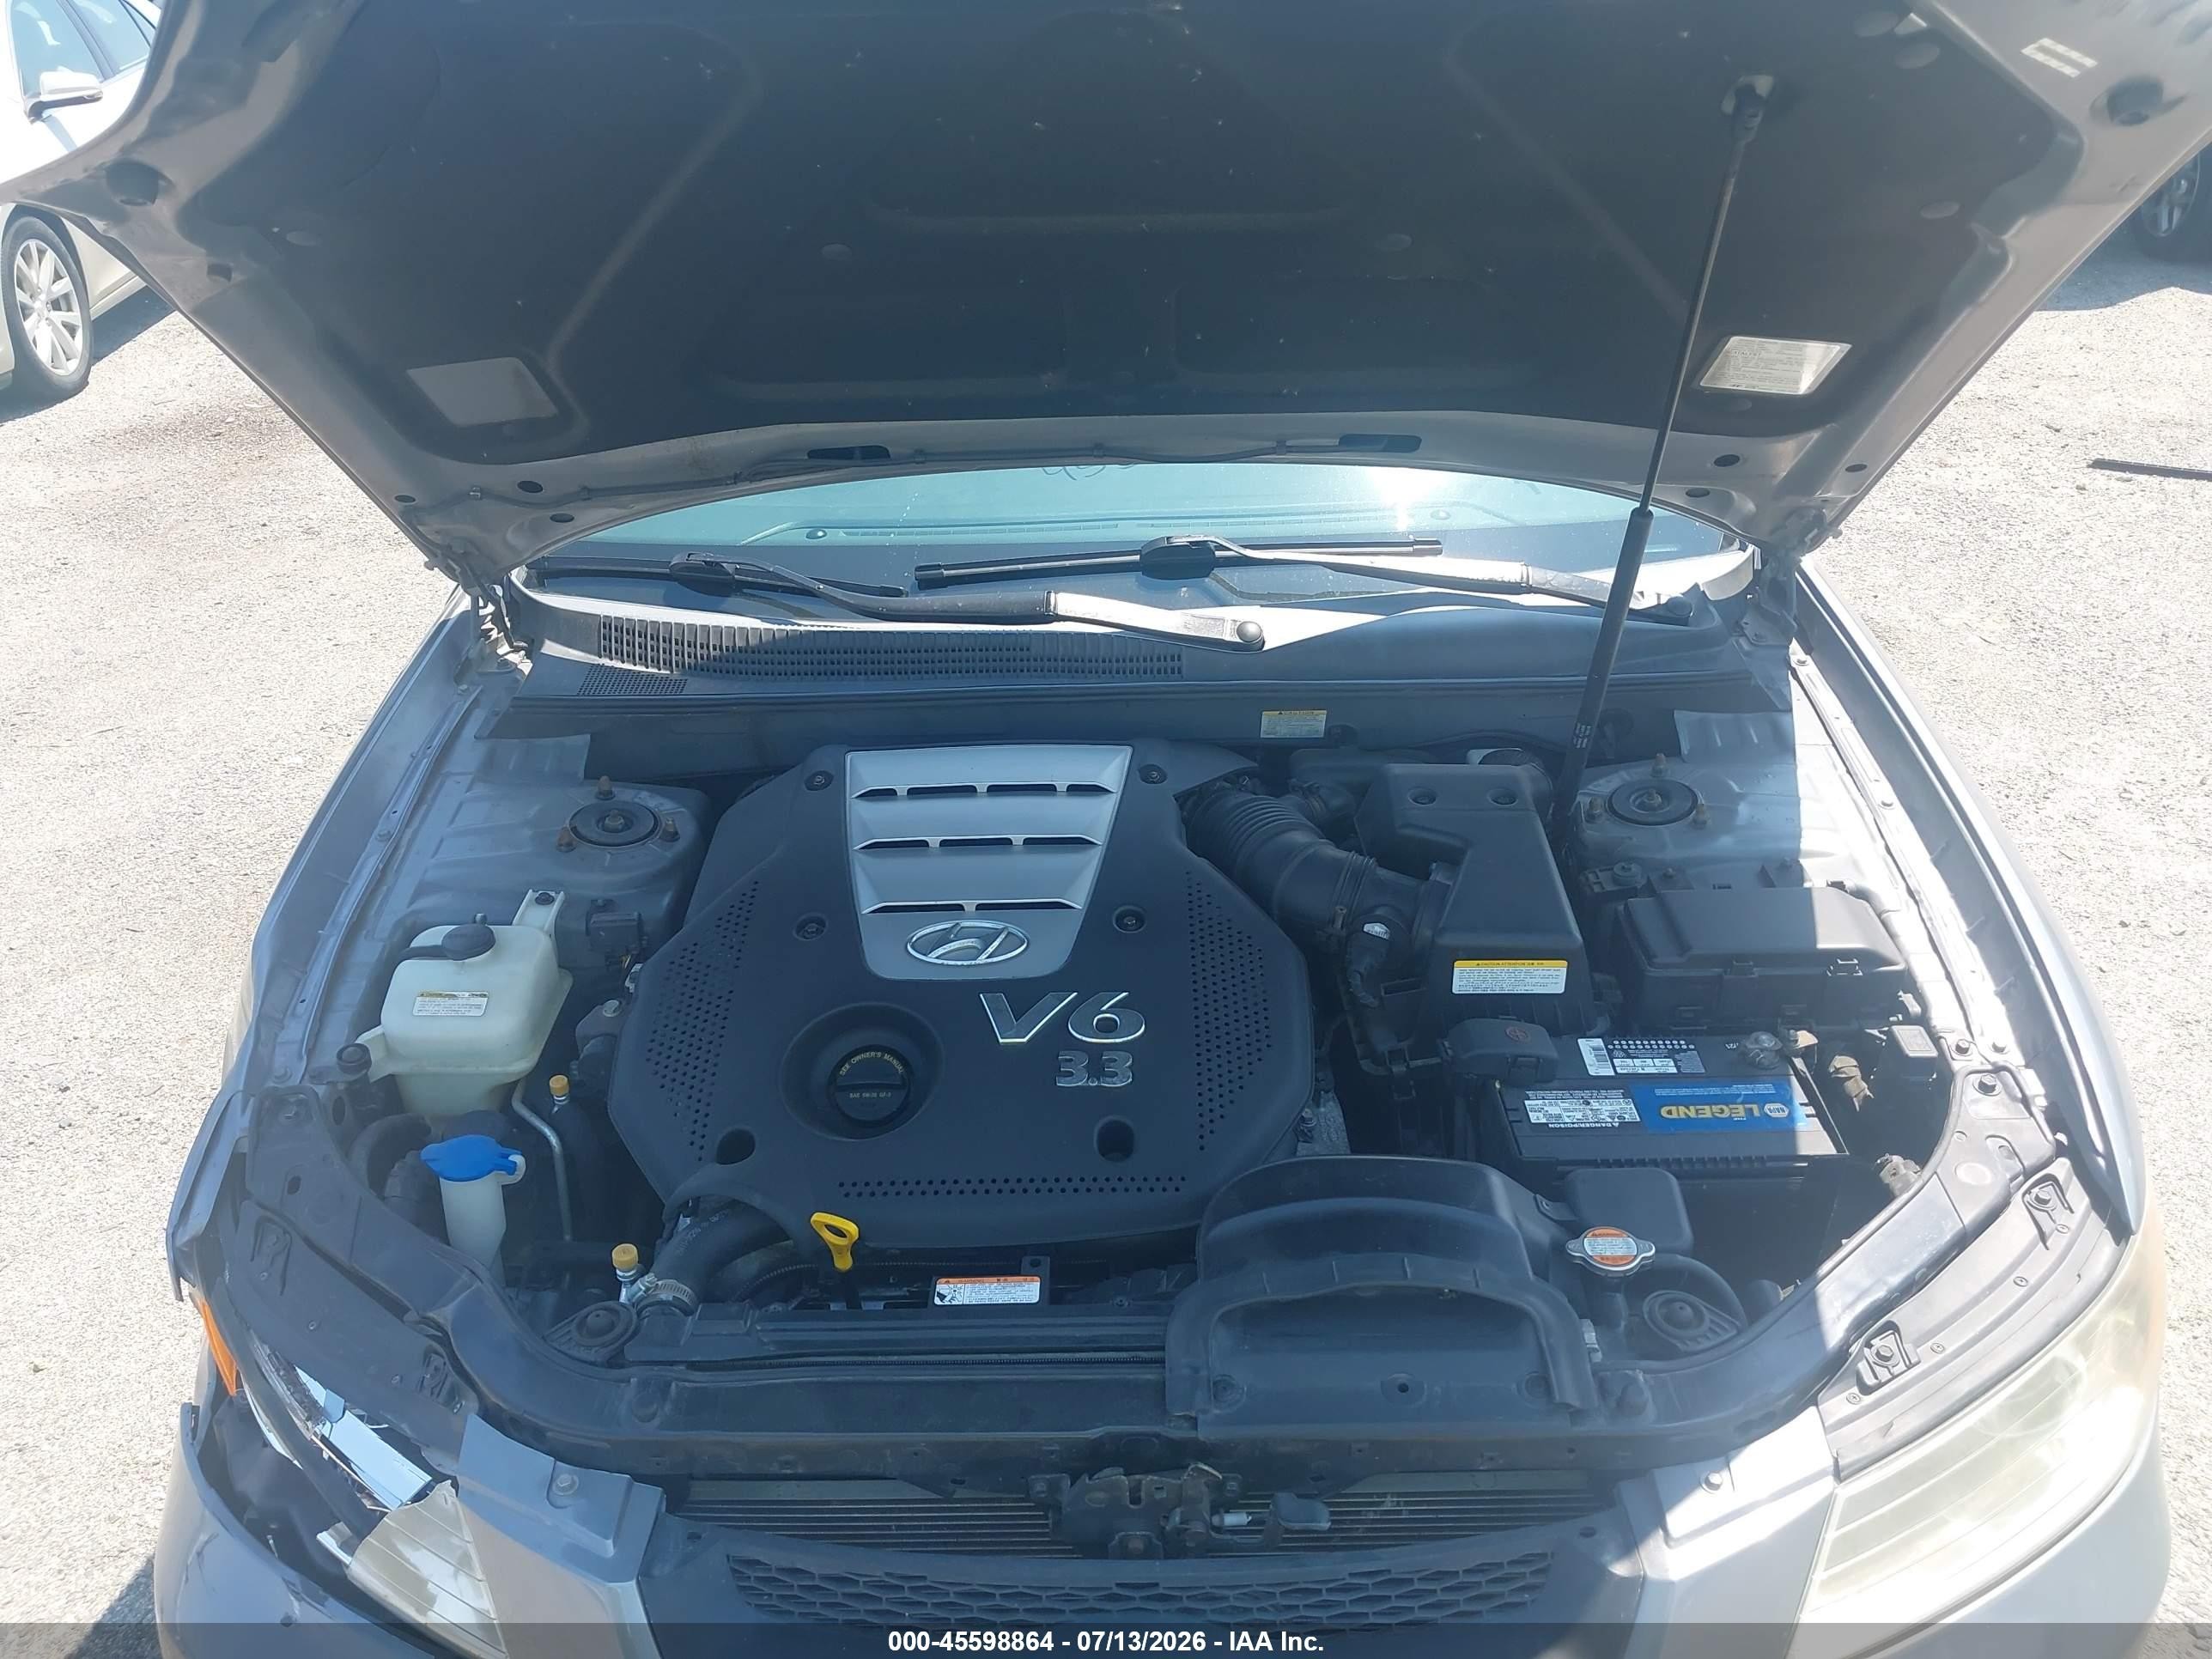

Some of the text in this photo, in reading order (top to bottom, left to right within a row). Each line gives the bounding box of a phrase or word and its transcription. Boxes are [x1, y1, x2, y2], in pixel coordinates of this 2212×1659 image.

[979, 991, 1146, 1043] V6
[840, 1051, 904, 1076] SEE OWNER'S MANUAL
[1055, 1050, 1133, 1087] 3.3
[1660, 1103, 1787, 1119] NAPA LEGEND
